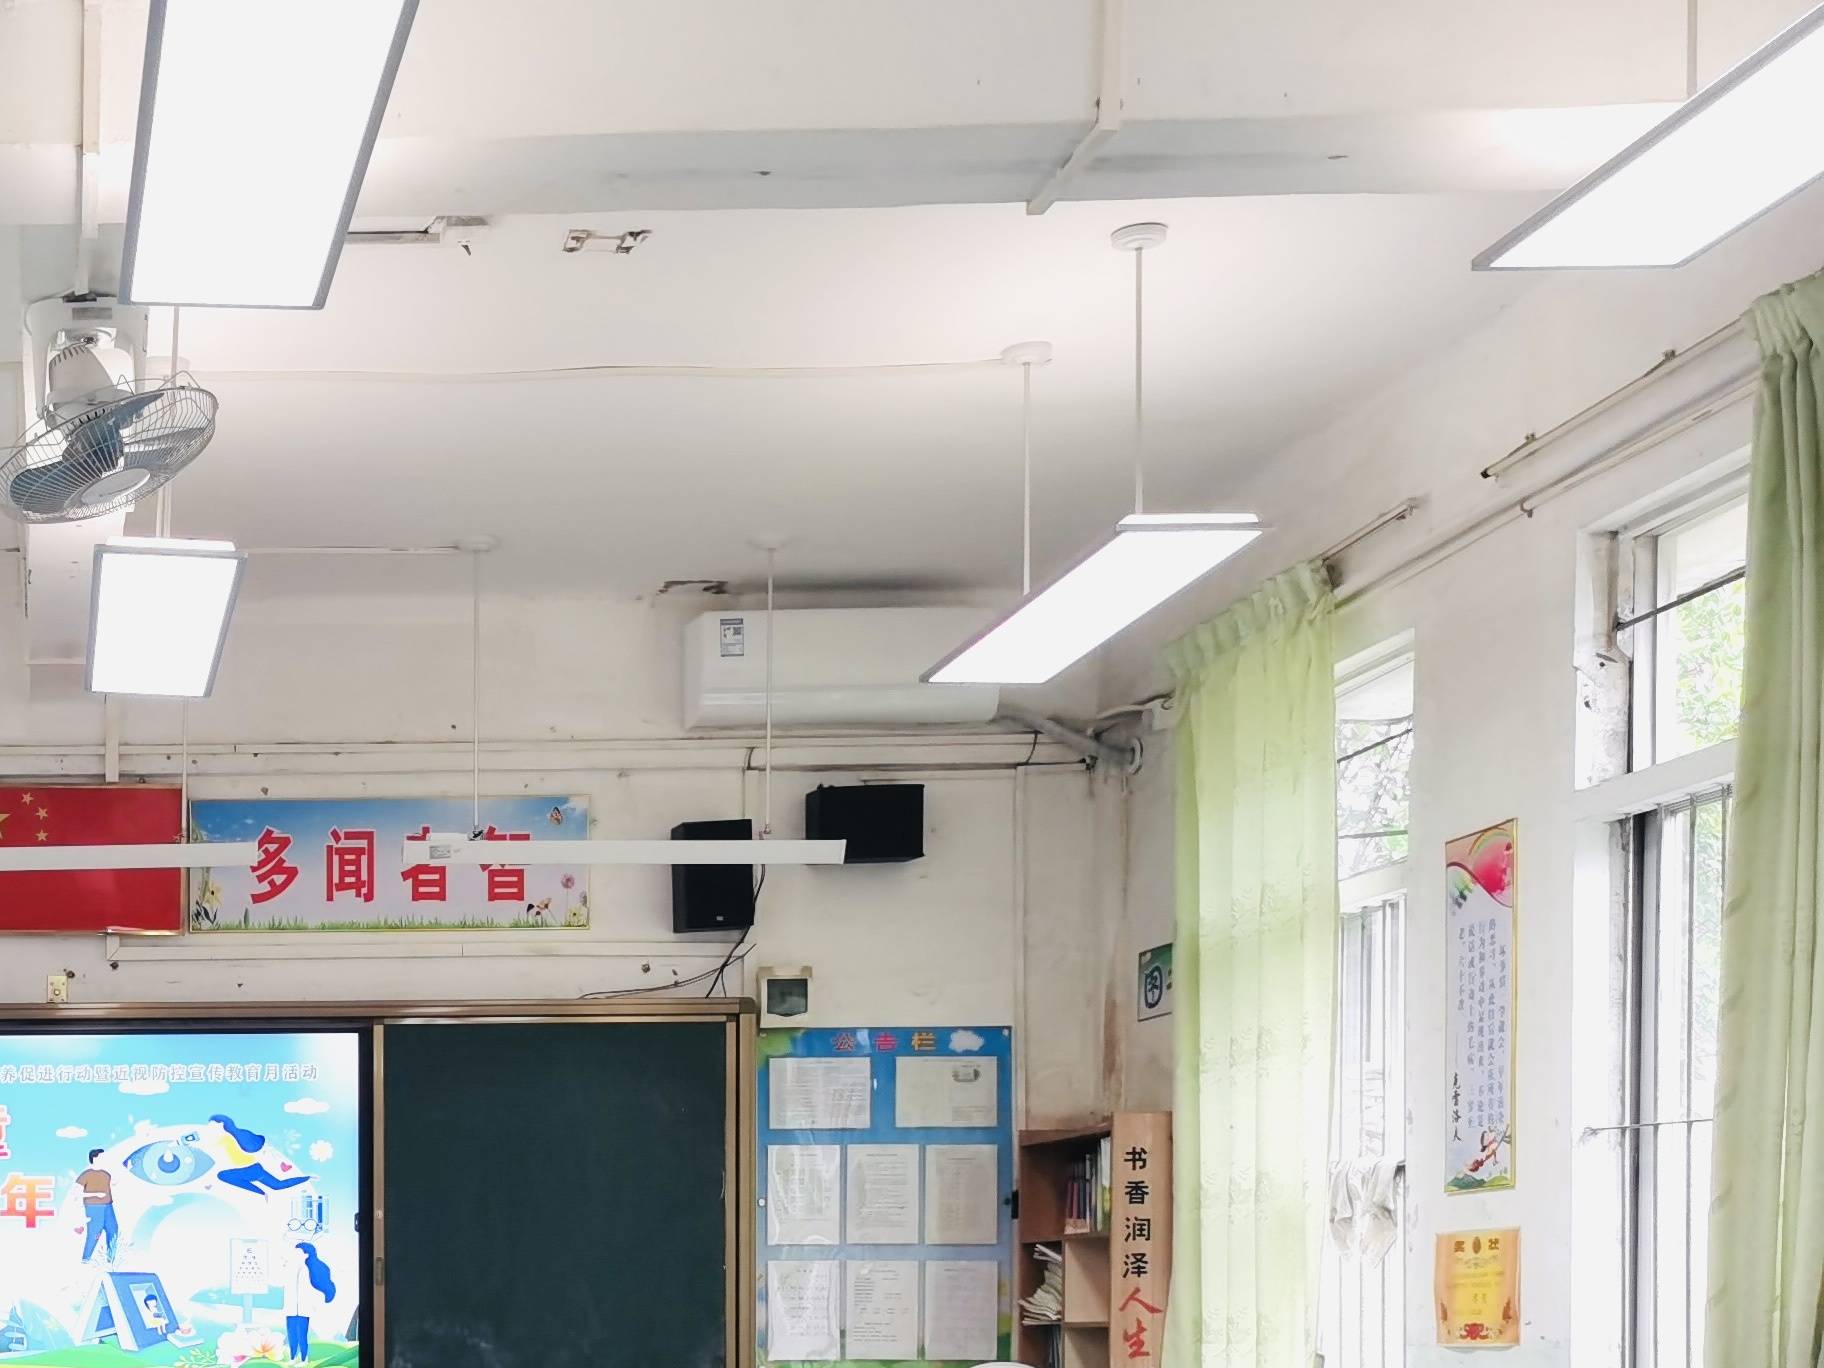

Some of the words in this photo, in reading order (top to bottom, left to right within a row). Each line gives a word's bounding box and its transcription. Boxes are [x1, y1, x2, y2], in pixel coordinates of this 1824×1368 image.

[1118, 1146, 1165, 1360] 书香润泽人生
